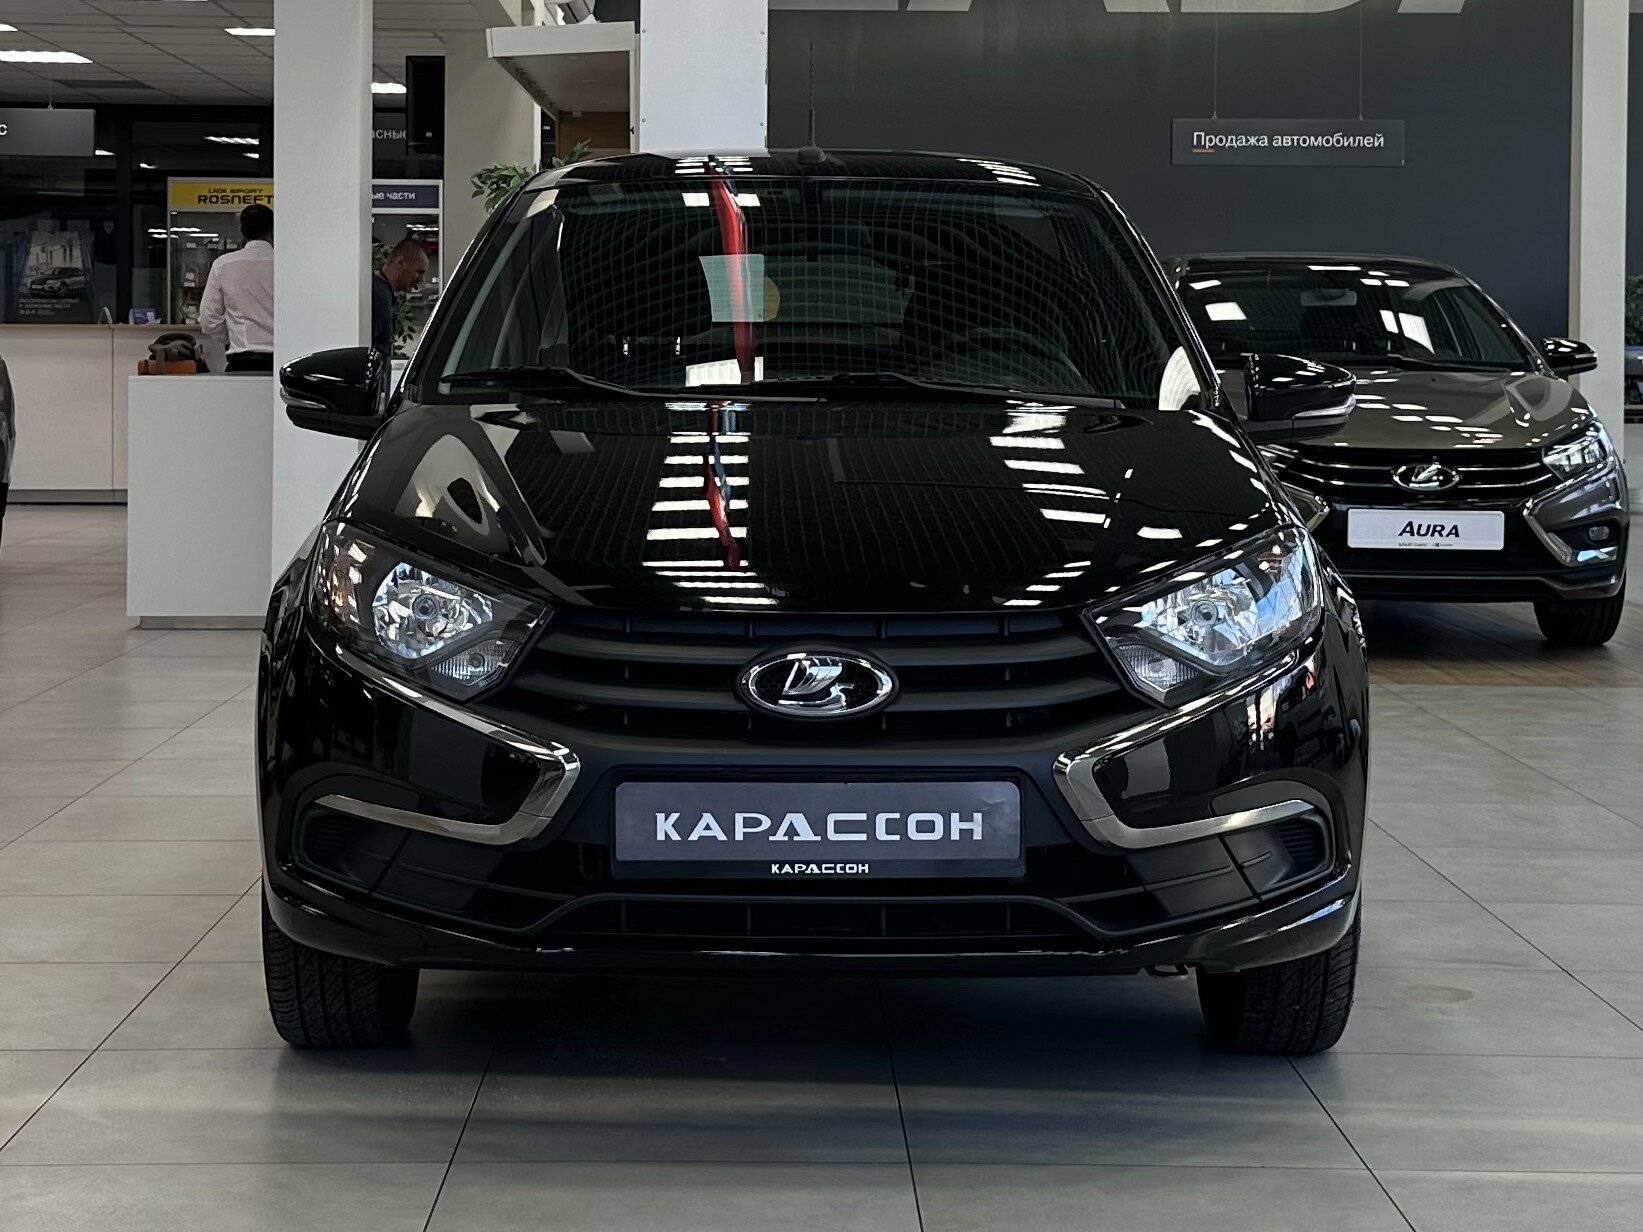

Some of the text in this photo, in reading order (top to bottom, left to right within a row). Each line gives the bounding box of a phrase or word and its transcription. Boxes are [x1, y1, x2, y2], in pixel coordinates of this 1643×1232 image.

[1193, 131, 1385, 149] Продажа автомобилей
[197, 194, 274, 205] ROSNEFT
[386, 192, 416, 200] части
[1398, 520, 1460, 538] AURA
